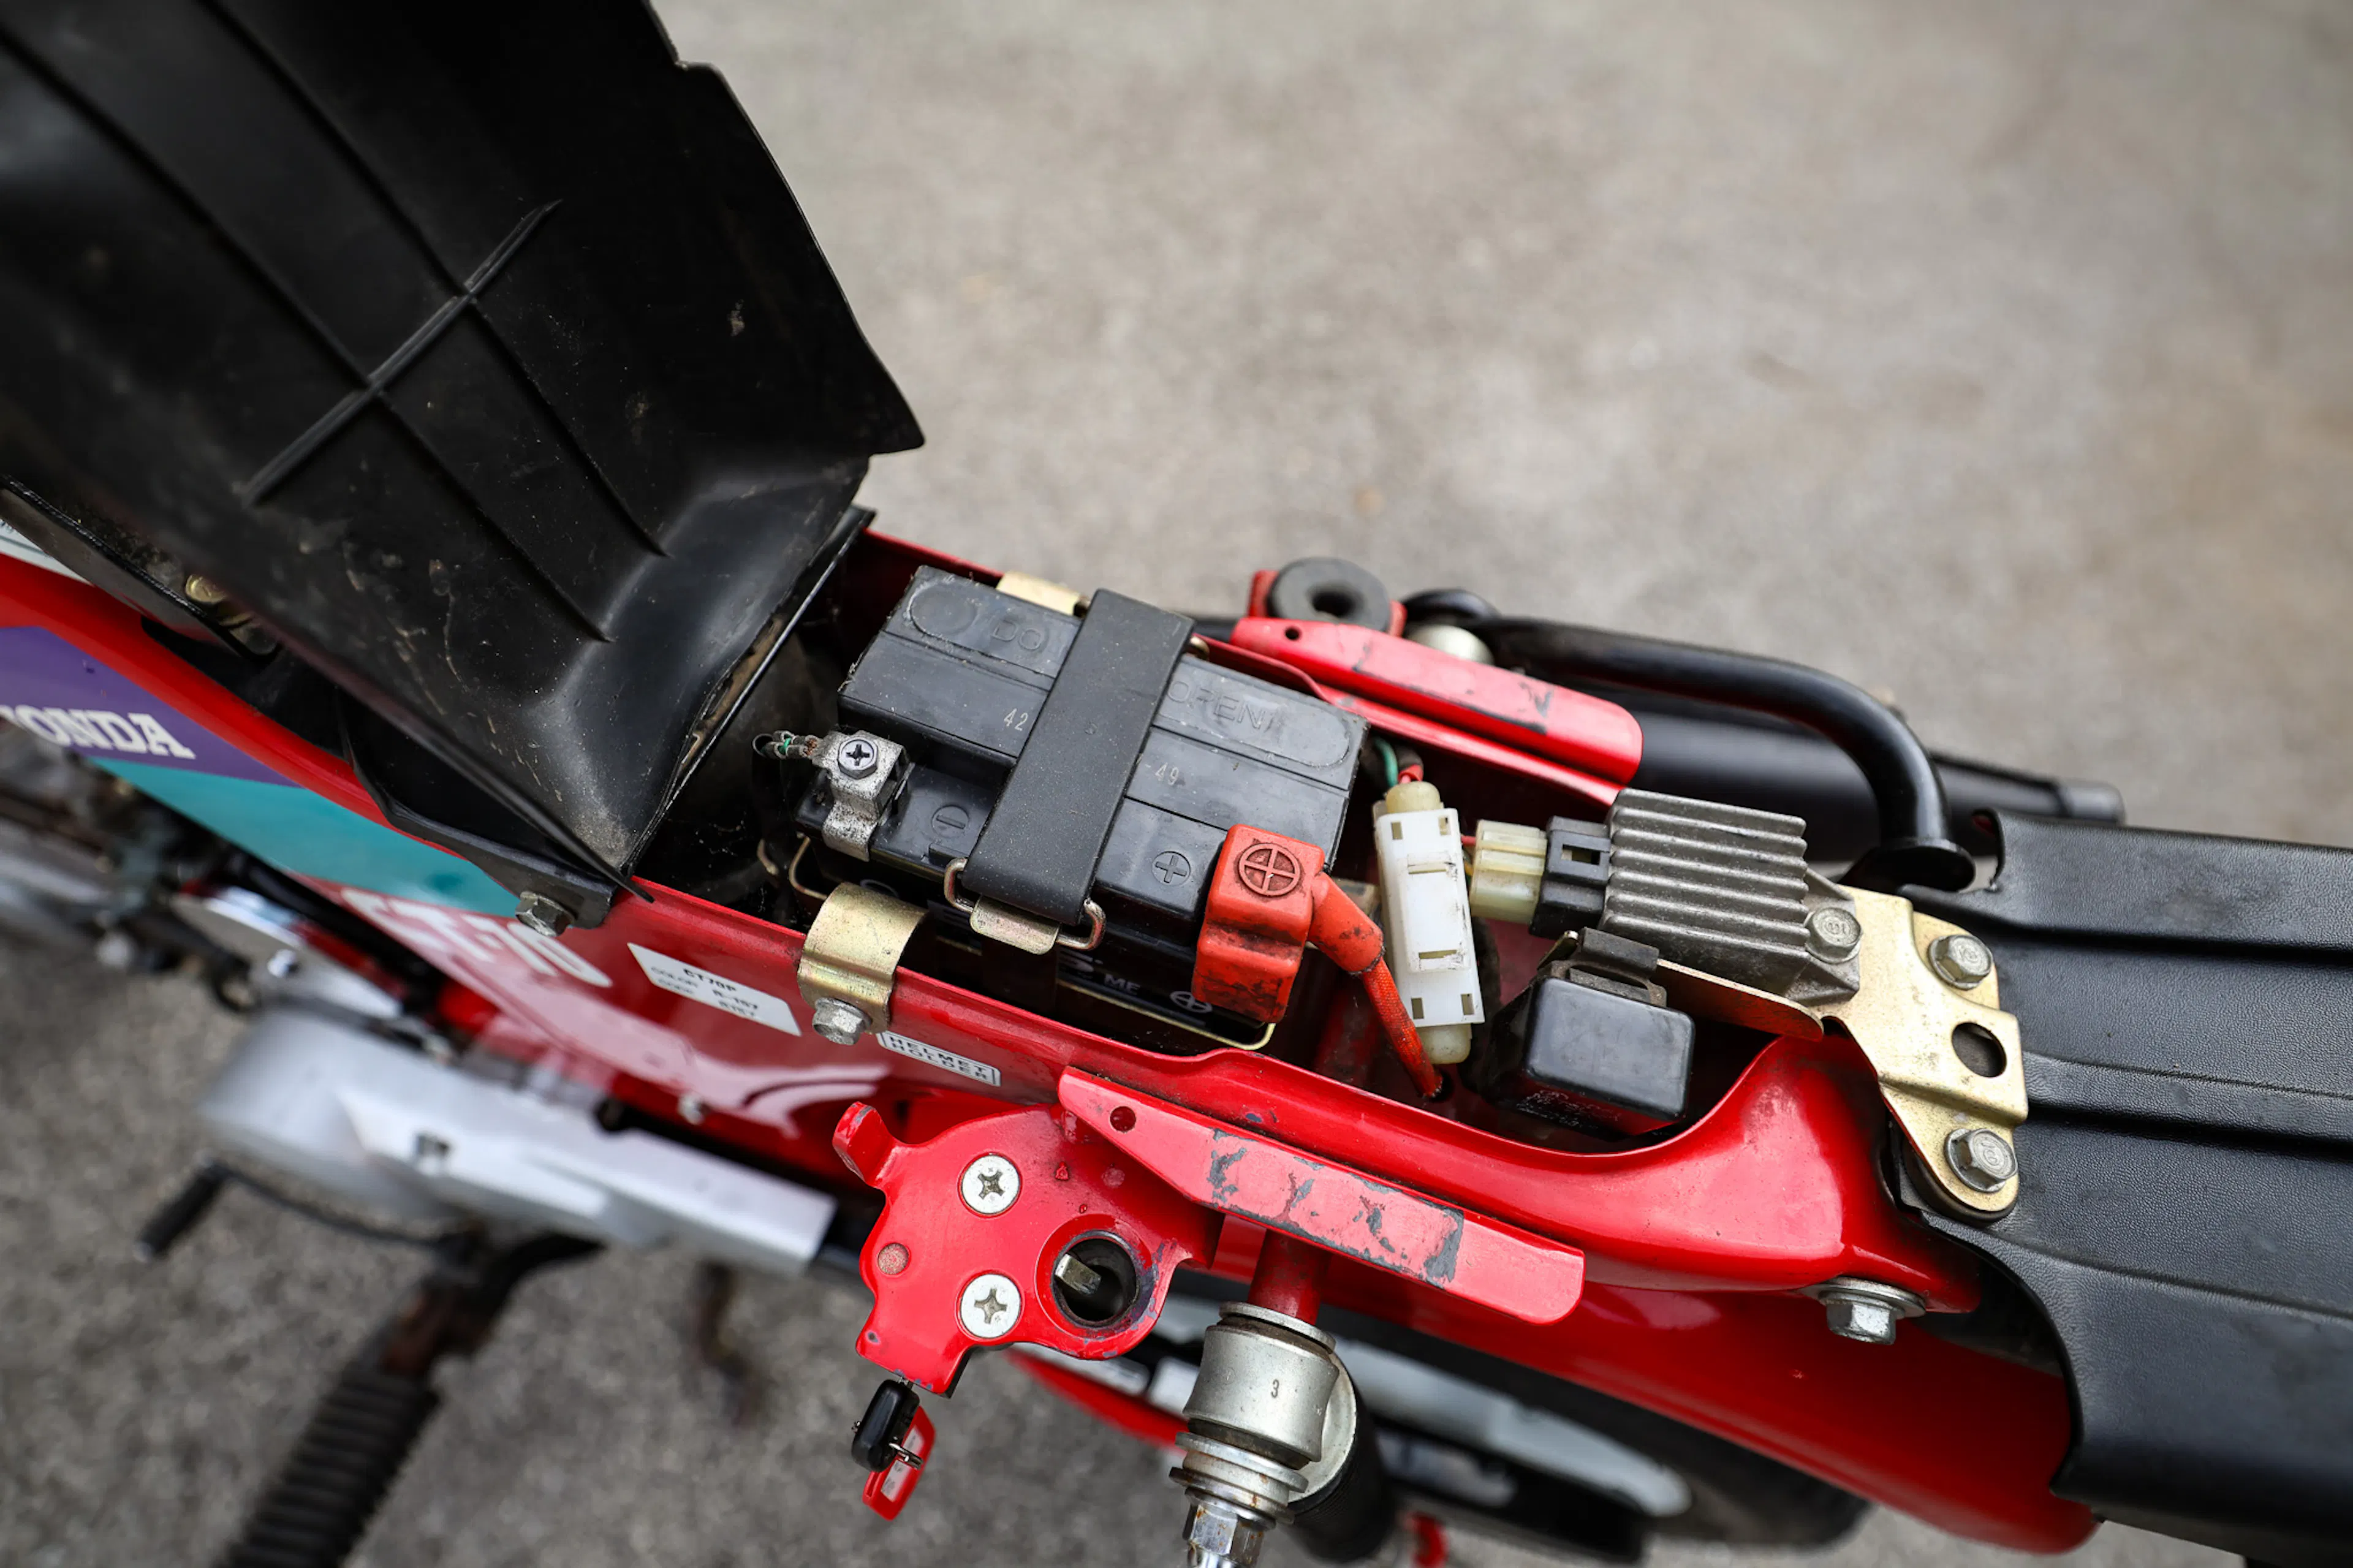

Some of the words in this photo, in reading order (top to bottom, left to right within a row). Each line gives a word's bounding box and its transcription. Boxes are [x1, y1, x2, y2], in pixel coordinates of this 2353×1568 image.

[0, 704, 196, 759] ONDA
[1002, 708, 1029, 732] 42
[1154, 761, 1180, 786] 49
[889, 1036, 987, 1072] HELMET
[892, 1042, 988, 1080] HOLDER
